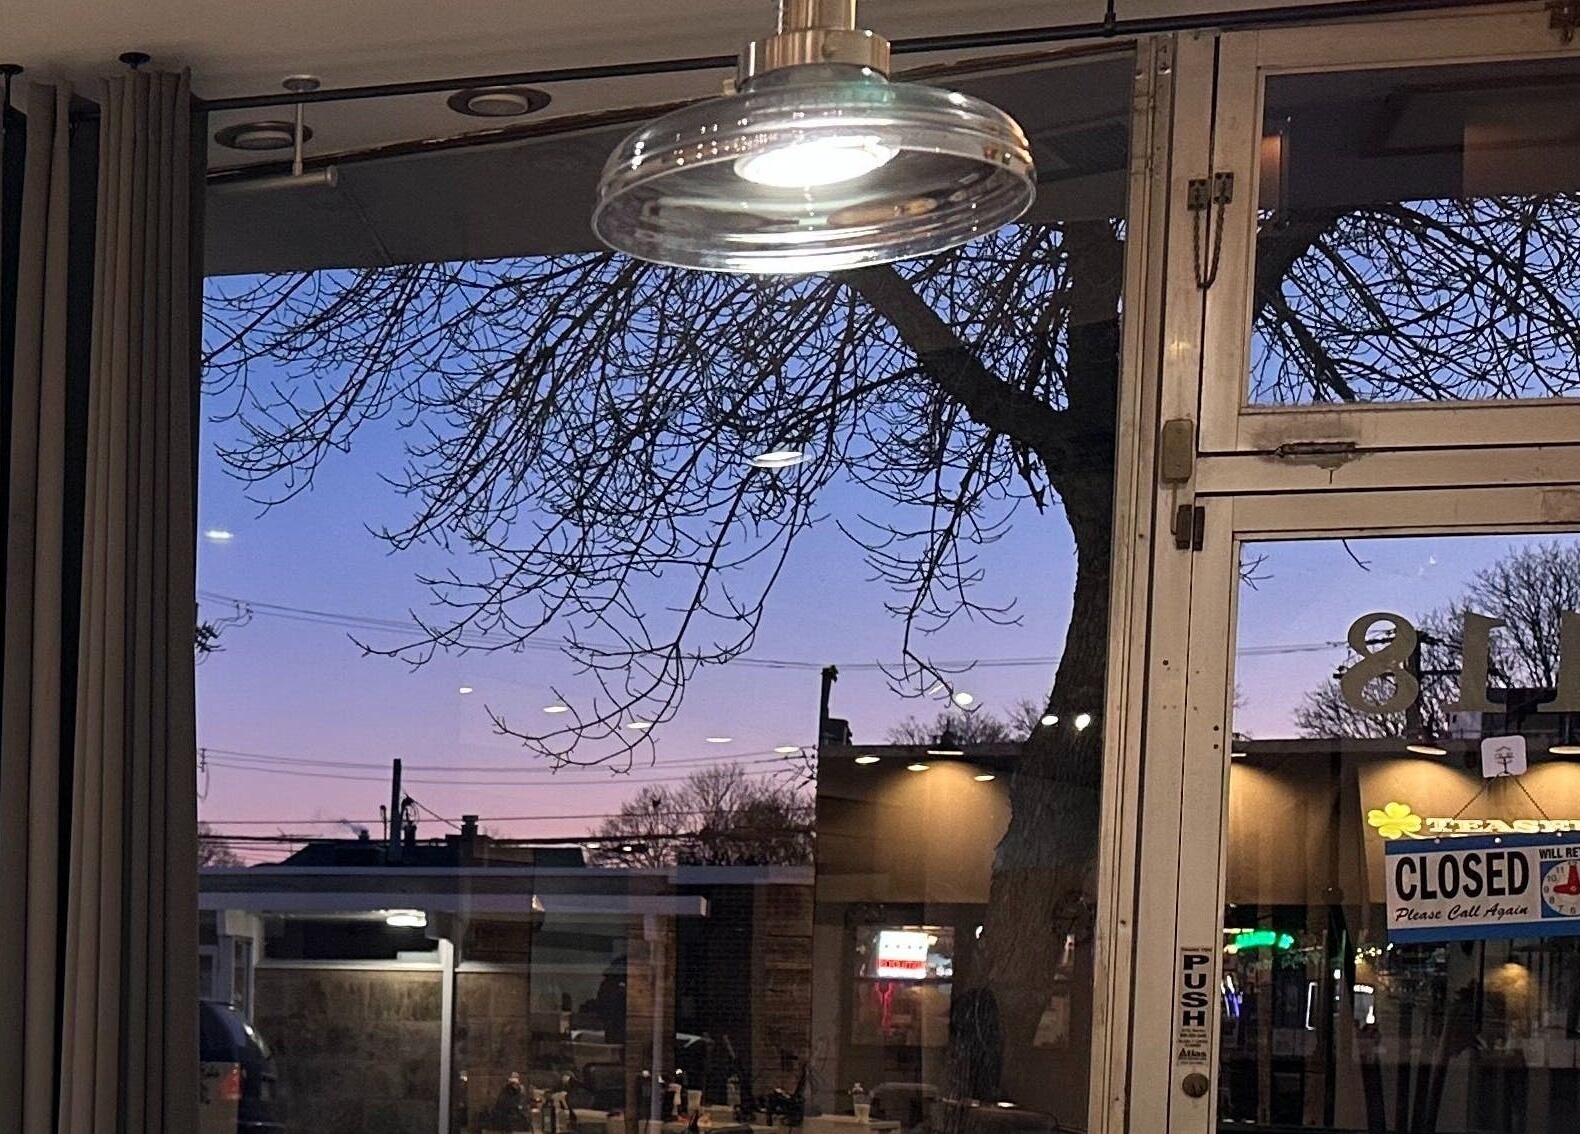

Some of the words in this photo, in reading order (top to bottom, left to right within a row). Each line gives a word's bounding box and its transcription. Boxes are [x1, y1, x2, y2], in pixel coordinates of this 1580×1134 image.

[1539, 848, 1563, 860] WILL
[1395, 851, 1530, 902] CLOSED
[1395, 906, 1442, 922] Please
[1447, 904, 1480, 921] Call
[1484, 902, 1529, 920] Again
[1181, 954, 1210, 1027] PUSH
